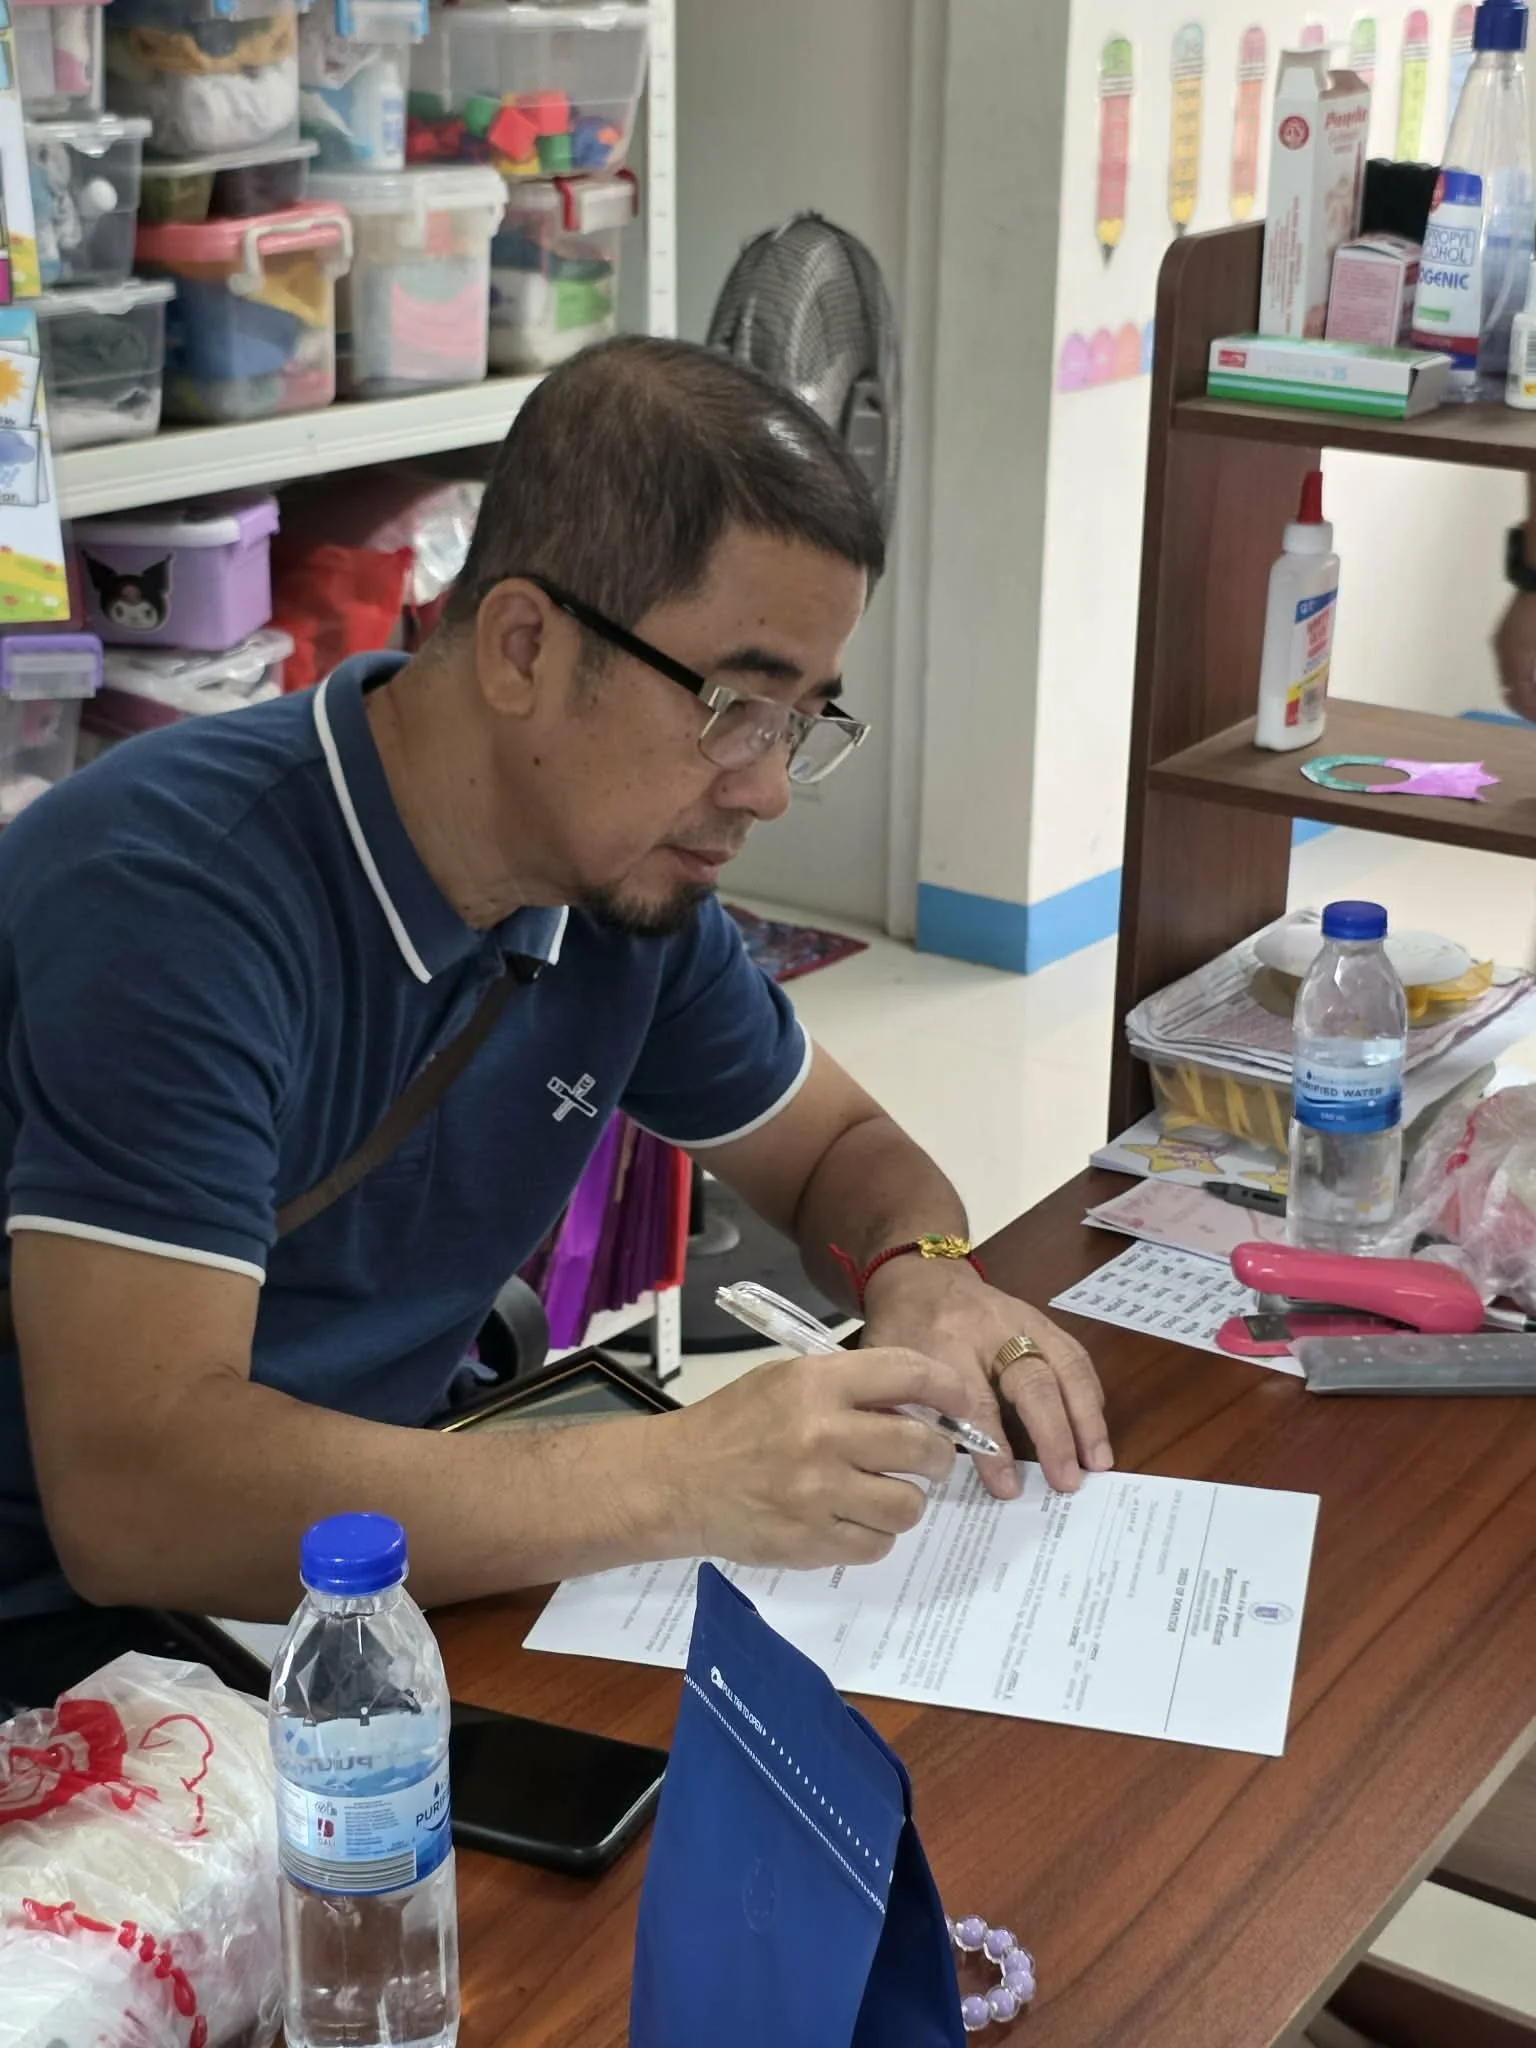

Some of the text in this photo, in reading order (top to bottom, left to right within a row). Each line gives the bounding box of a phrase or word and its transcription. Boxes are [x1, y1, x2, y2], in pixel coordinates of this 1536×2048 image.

[1342, 1087, 1383, 1098] WATER
[722, 1682, 762, 1734] PULL TAB TO OPEN
[416, 1790, 450, 1828] PURIF
